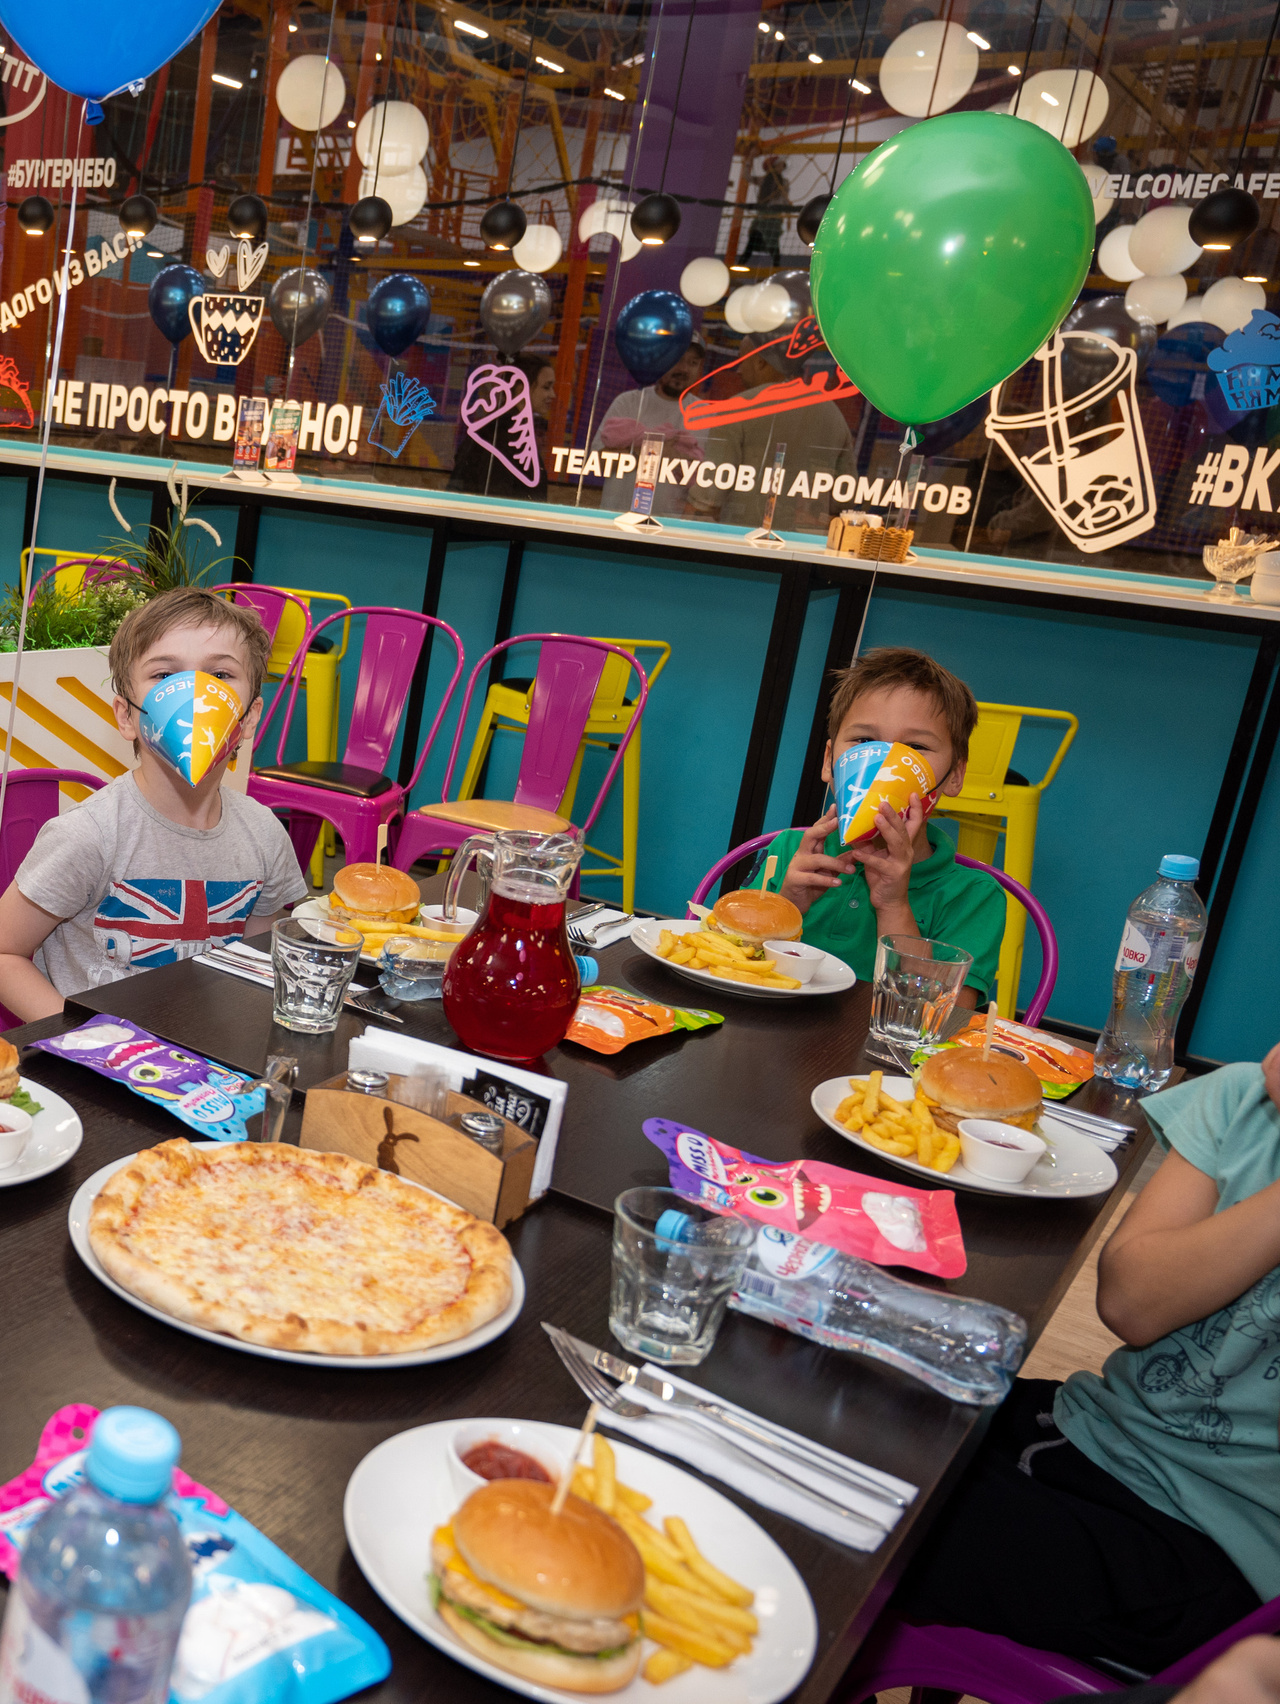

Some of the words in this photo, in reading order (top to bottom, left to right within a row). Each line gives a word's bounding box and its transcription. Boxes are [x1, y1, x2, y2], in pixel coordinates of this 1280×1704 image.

[7, 157, 116, 189] #БУРГЕРНЕБО
[53, 259, 85, 296] ИЗ
[45, 379, 85, 425] НЕ
[86, 382, 209, 439] ПРОСТО
[551, 446, 637, 479] ТЕАТР
[658, 457, 757, 492] КУСОВ
[787, 470, 972, 515] АРОМАТОВ
[1189, 444, 1280, 512] #ВК
[840, 748, 881, 768] НЕБО
[901, 756, 929, 795] НЕБО
